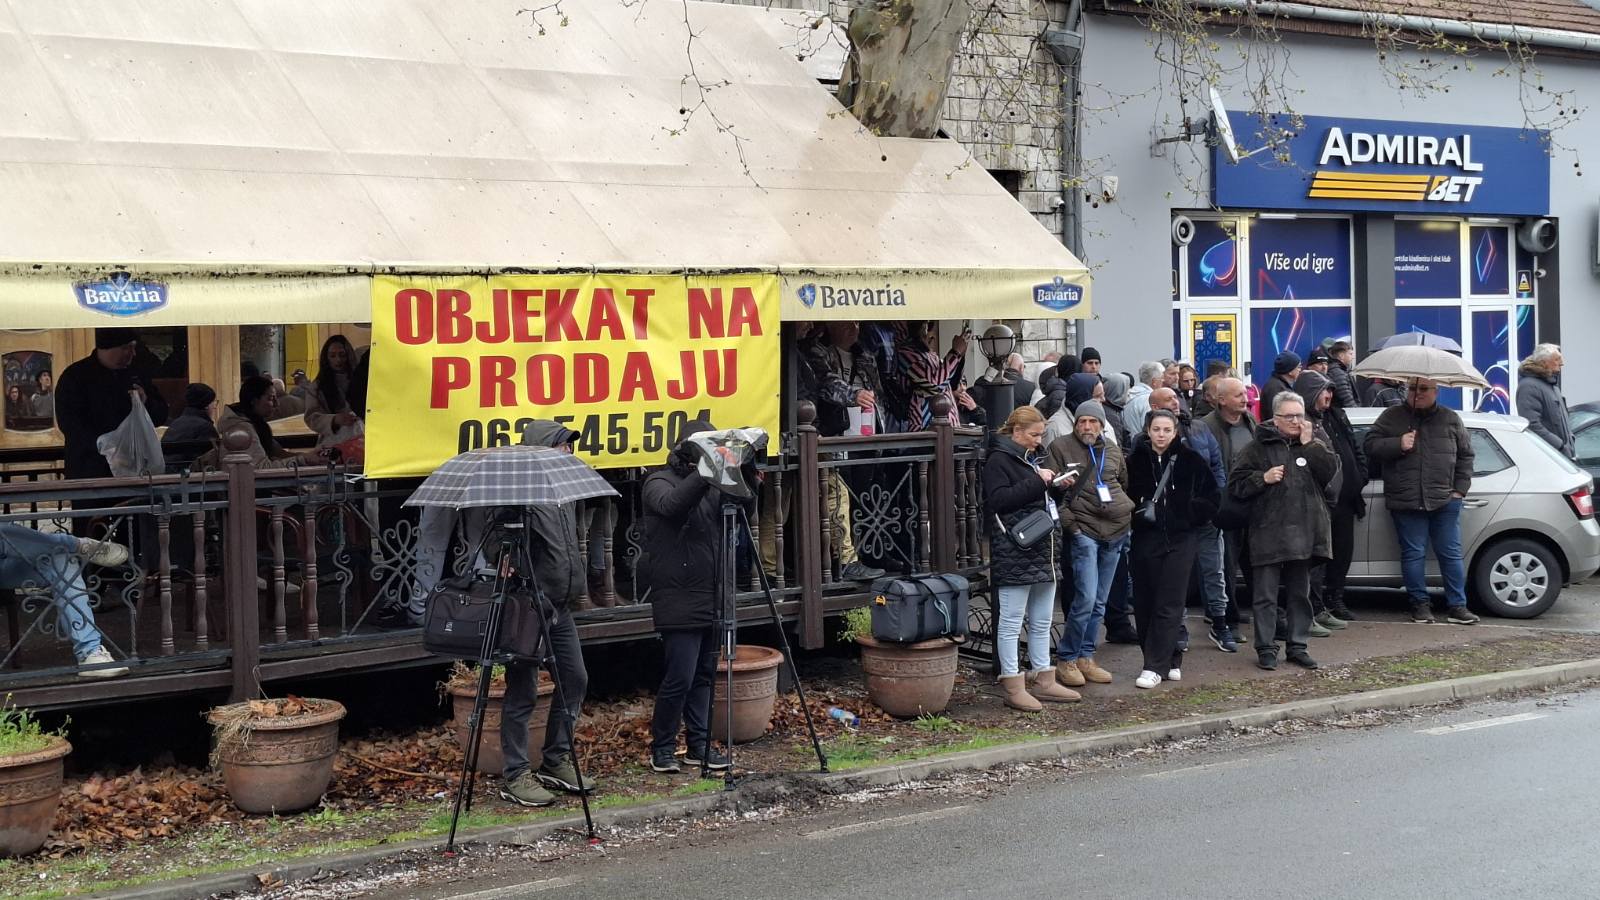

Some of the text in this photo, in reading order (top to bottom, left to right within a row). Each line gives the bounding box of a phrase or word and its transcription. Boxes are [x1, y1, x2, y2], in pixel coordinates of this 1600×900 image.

[1319, 127, 1484, 172] ADMIRAL
[1427, 175, 1483, 202] BET
[1264, 252, 1335, 274] Više od igre
[84, 287, 162, 305] Bavaria
[819, 284, 907, 309] Bavaria
[1037, 287, 1079, 302] Bavaria
[394, 286, 763, 345] OBJEKAT NA
[429, 348, 738, 409] PRODAJU
